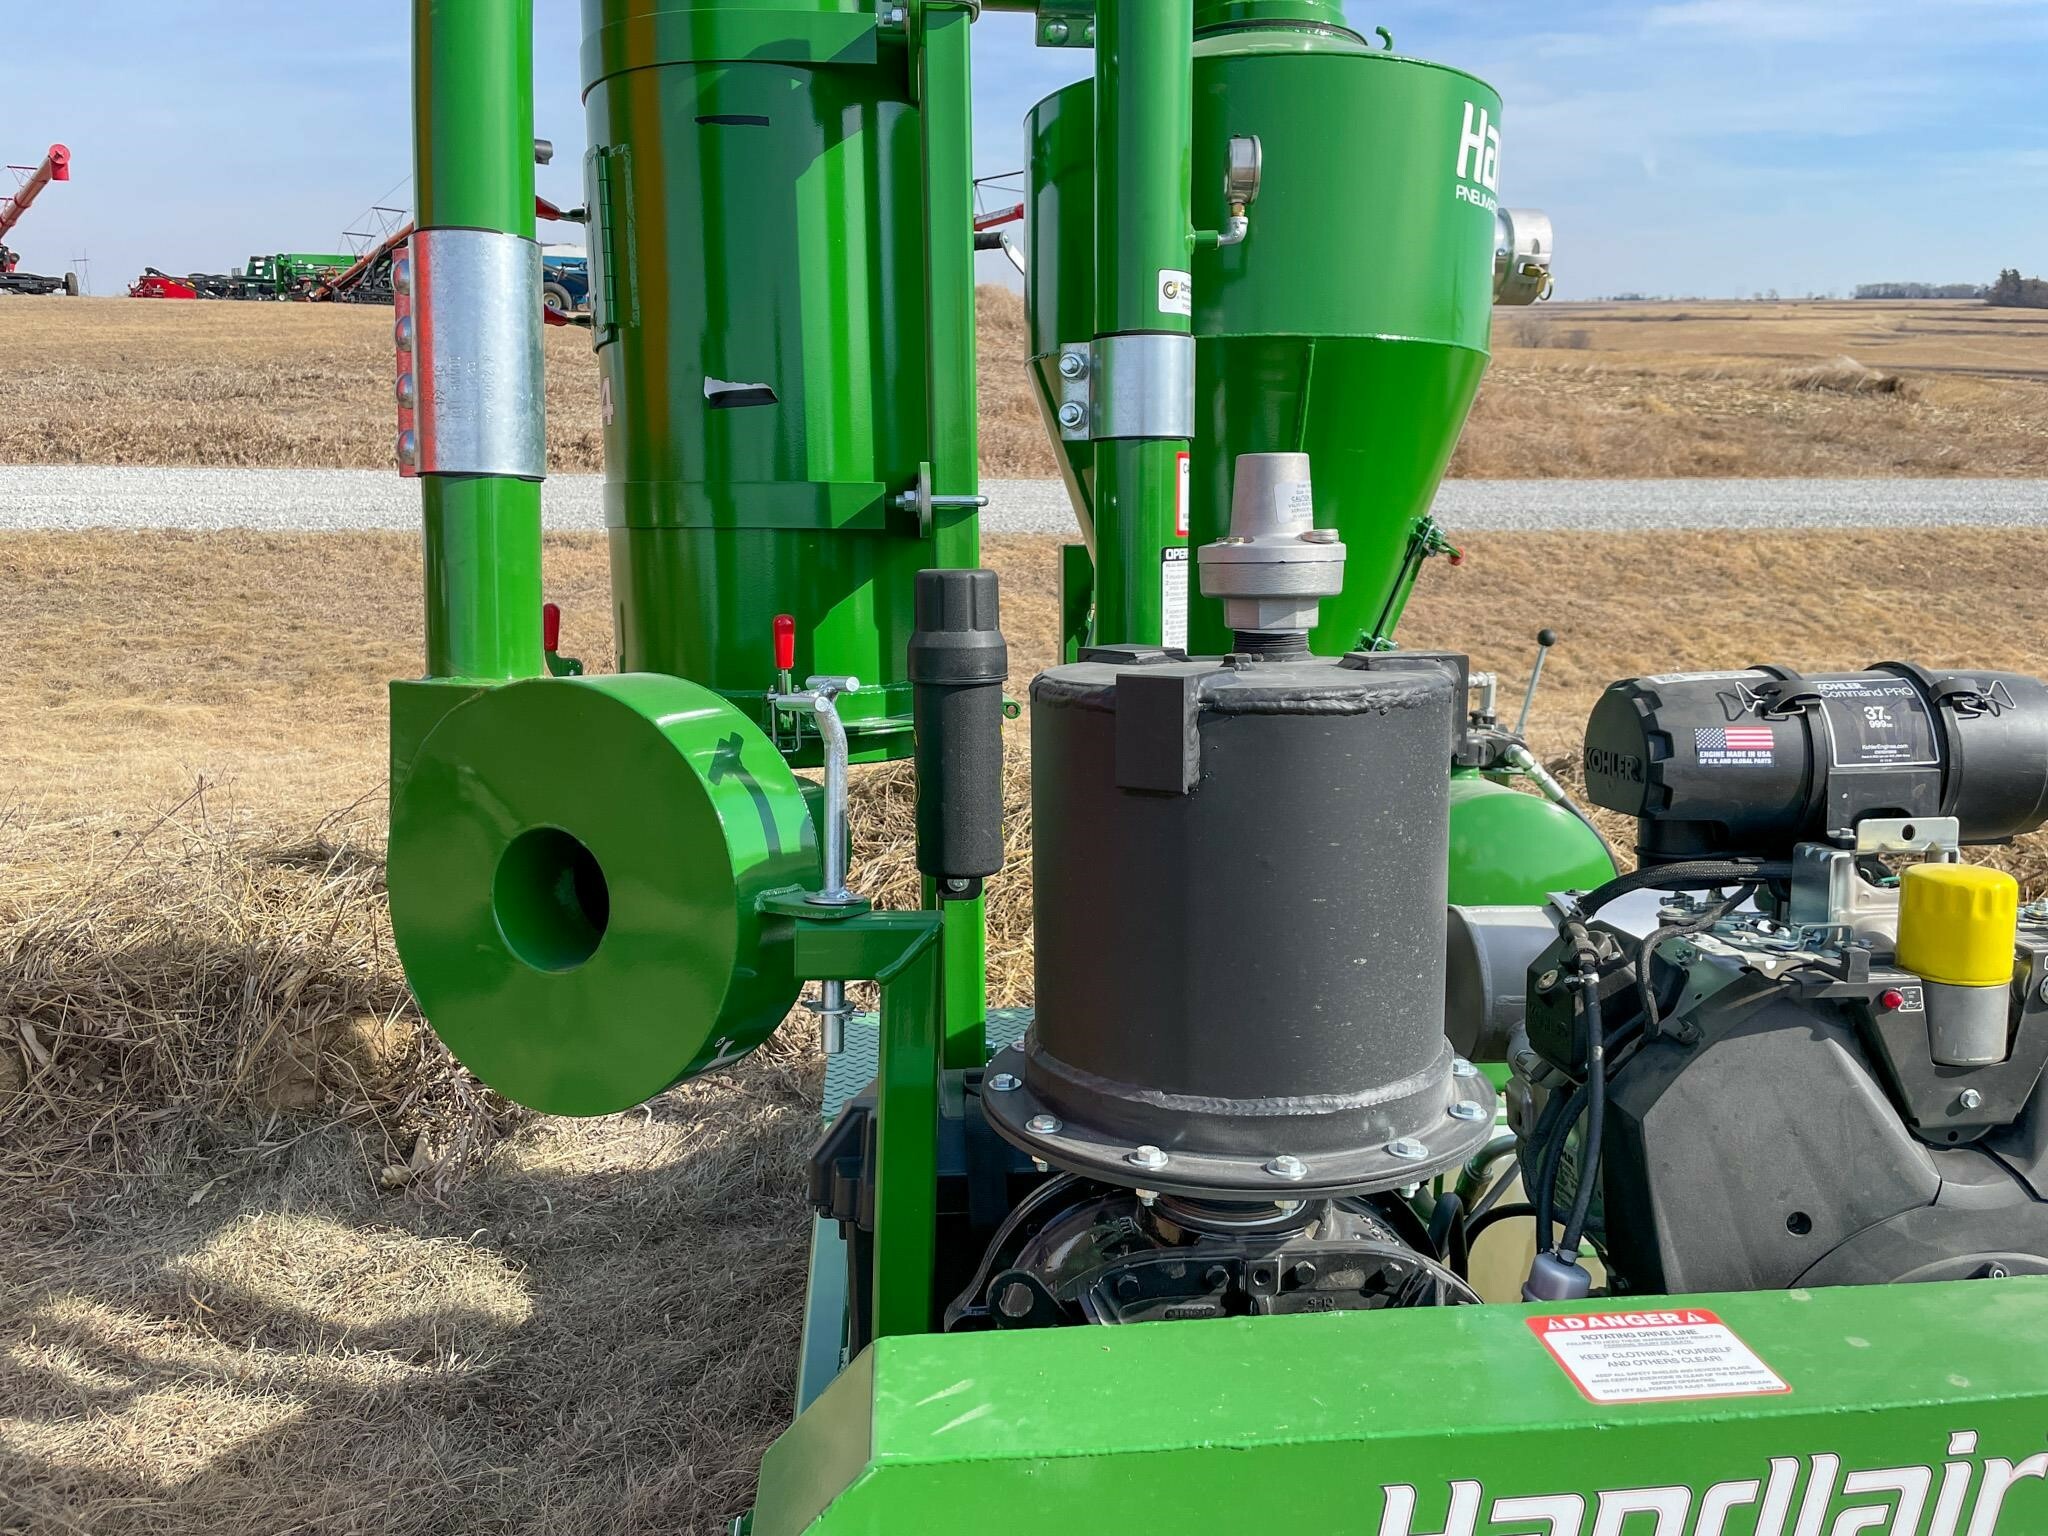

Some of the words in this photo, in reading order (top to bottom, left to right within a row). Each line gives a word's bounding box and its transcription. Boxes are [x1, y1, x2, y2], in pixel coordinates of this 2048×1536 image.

[1165, 548, 1189, 560] OPE
[1820, 687, 1883, 698] Command
[1884, 687, 1914, 697] PRO
[1563, 1313, 1683, 1329] DANGER
[1581, 1332, 1636, 1341] ROTATING
[1638, 1330, 1672, 1338] DRIVE
[1672, 1328, 1699, 1336] LINE
[1612, 1350, 1673, 1359] CLOTHING,
[1673, 1347, 1732, 1355] YOURSELF
[1632, 1357, 1680, 1366] OTHERS
[1681, 1355, 1722, 1363] CLEAR!
